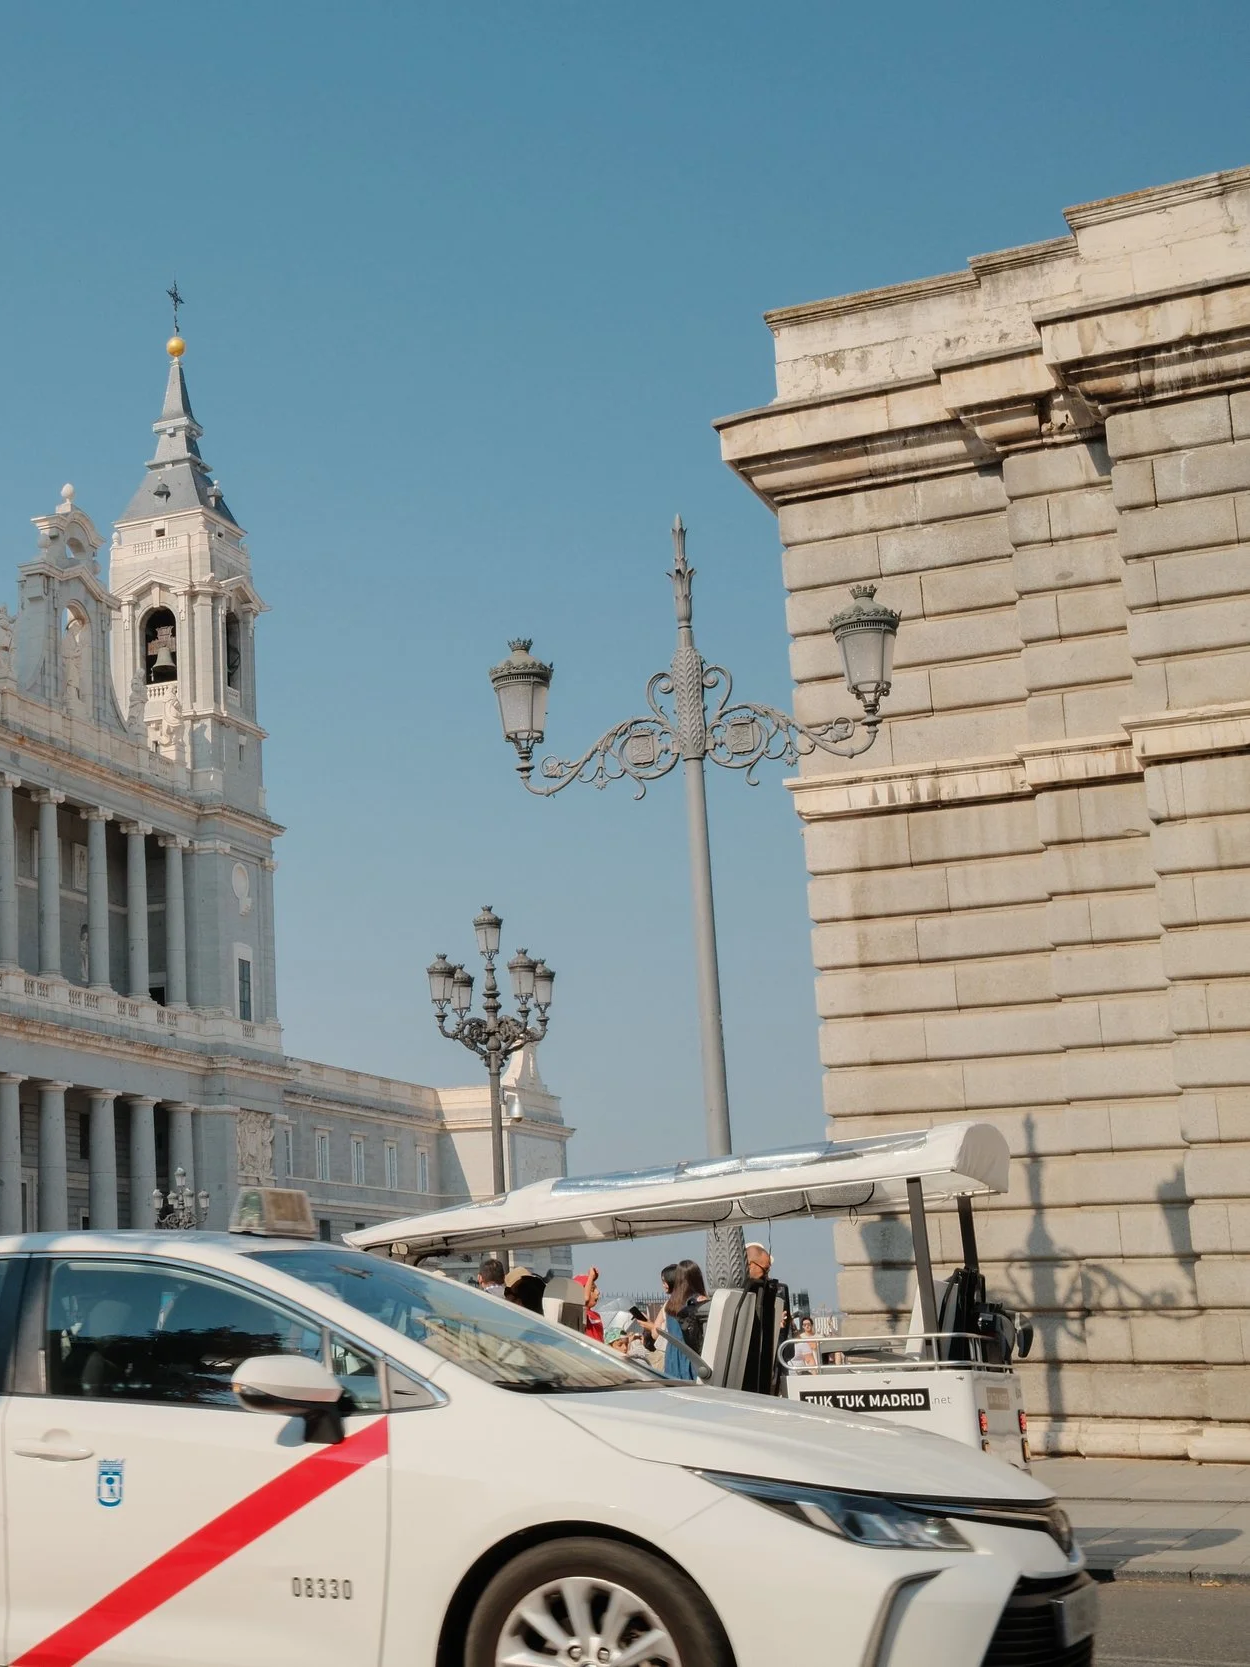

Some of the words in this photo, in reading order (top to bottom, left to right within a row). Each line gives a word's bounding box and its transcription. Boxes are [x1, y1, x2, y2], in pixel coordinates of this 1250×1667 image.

[805, 1395, 834, 1408] TUK
[836, 1394, 866, 1408] TUK
[869, 1392, 925, 1408] MADRID
[931, 1395, 951, 1405] .net
[292, 1576, 352, 1600] 08330
